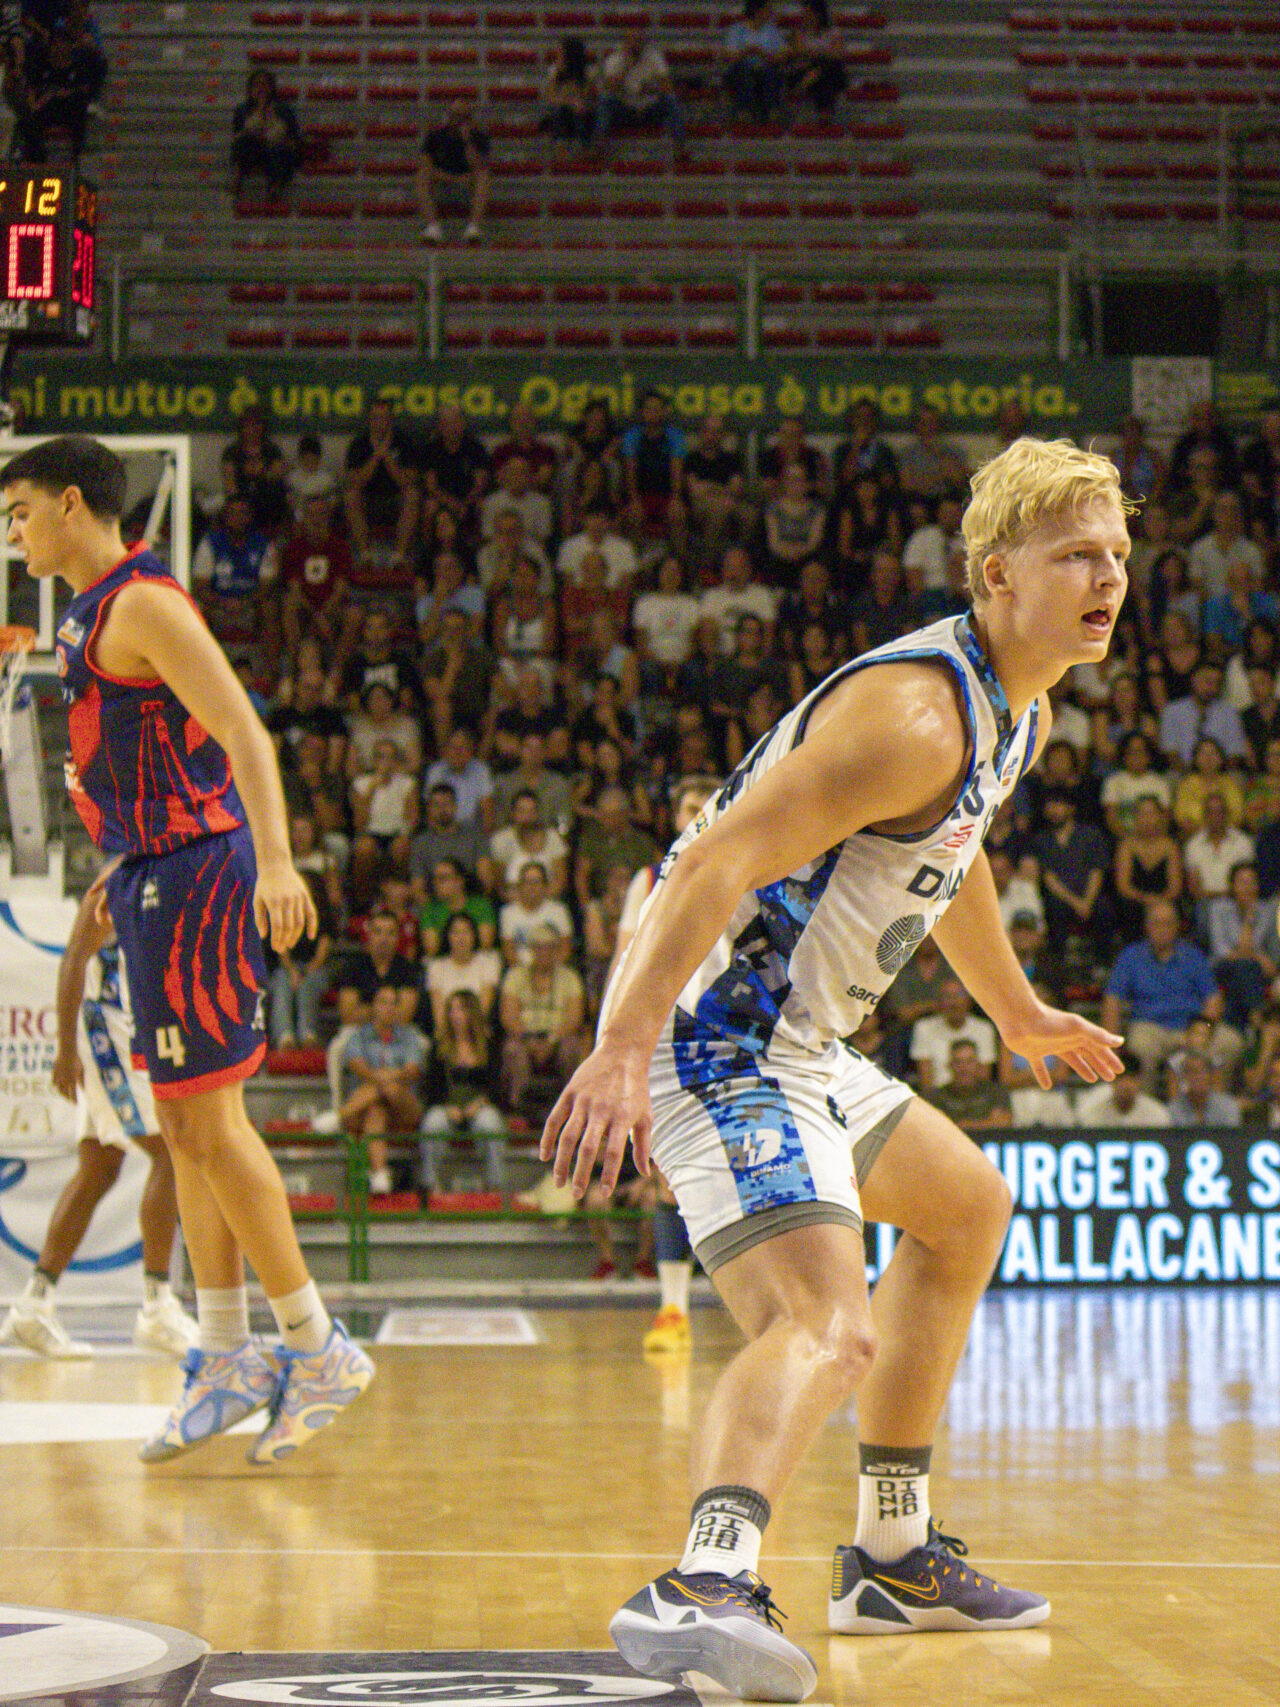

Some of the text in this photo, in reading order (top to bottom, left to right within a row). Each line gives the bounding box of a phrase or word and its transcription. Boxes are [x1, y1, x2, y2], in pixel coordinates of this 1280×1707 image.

[60, 379, 217, 417] mutuo
[272, 384, 363, 416] una
[776, 373, 805, 416] è
[156, 1025, 185, 1068] 4
[1183, 1140, 1233, 1209] &
